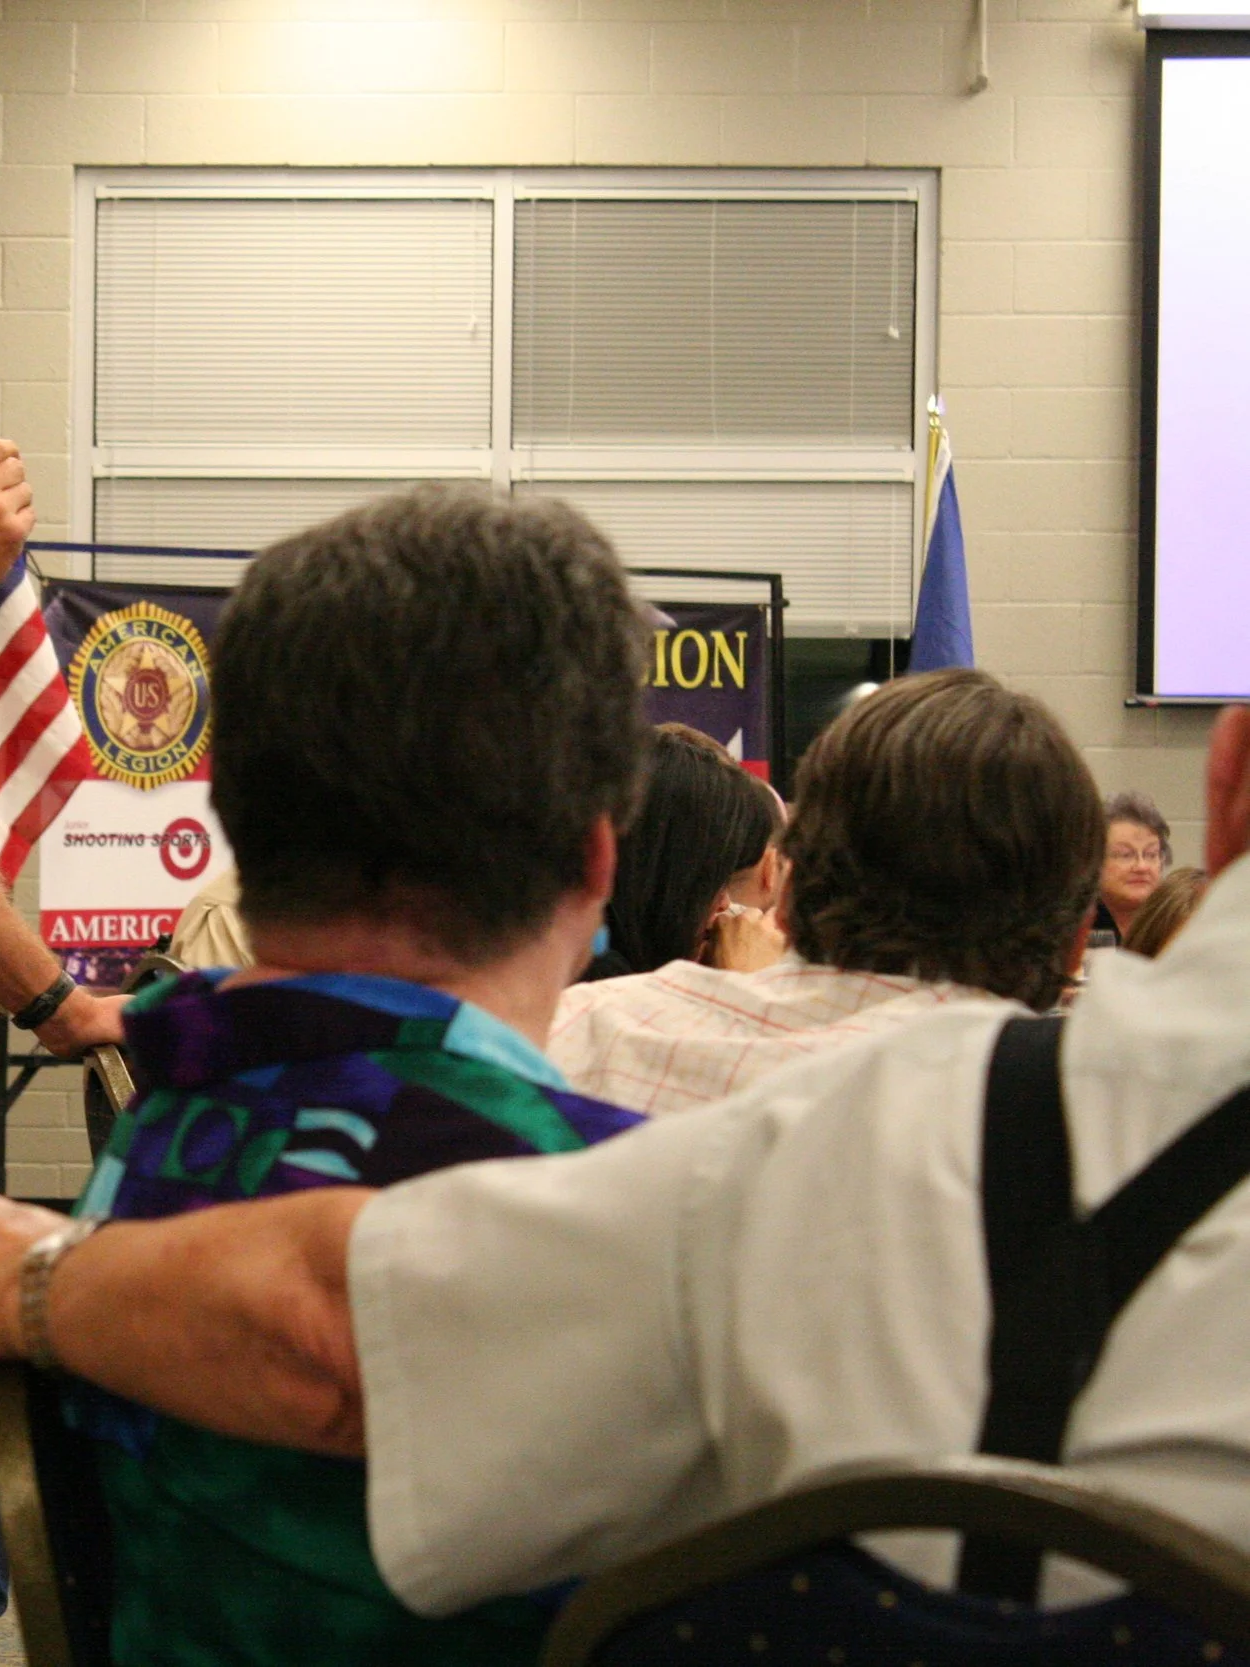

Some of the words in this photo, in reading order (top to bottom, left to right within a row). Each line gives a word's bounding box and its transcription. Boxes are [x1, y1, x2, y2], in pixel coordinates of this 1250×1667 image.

[89, 621, 201, 677] AMERICAN
[133, 683, 159, 708] US
[102, 742, 188, 772] LEGION
[63, 833, 145, 847] SHOOTING
[150, 833, 211, 847] SPORTS
